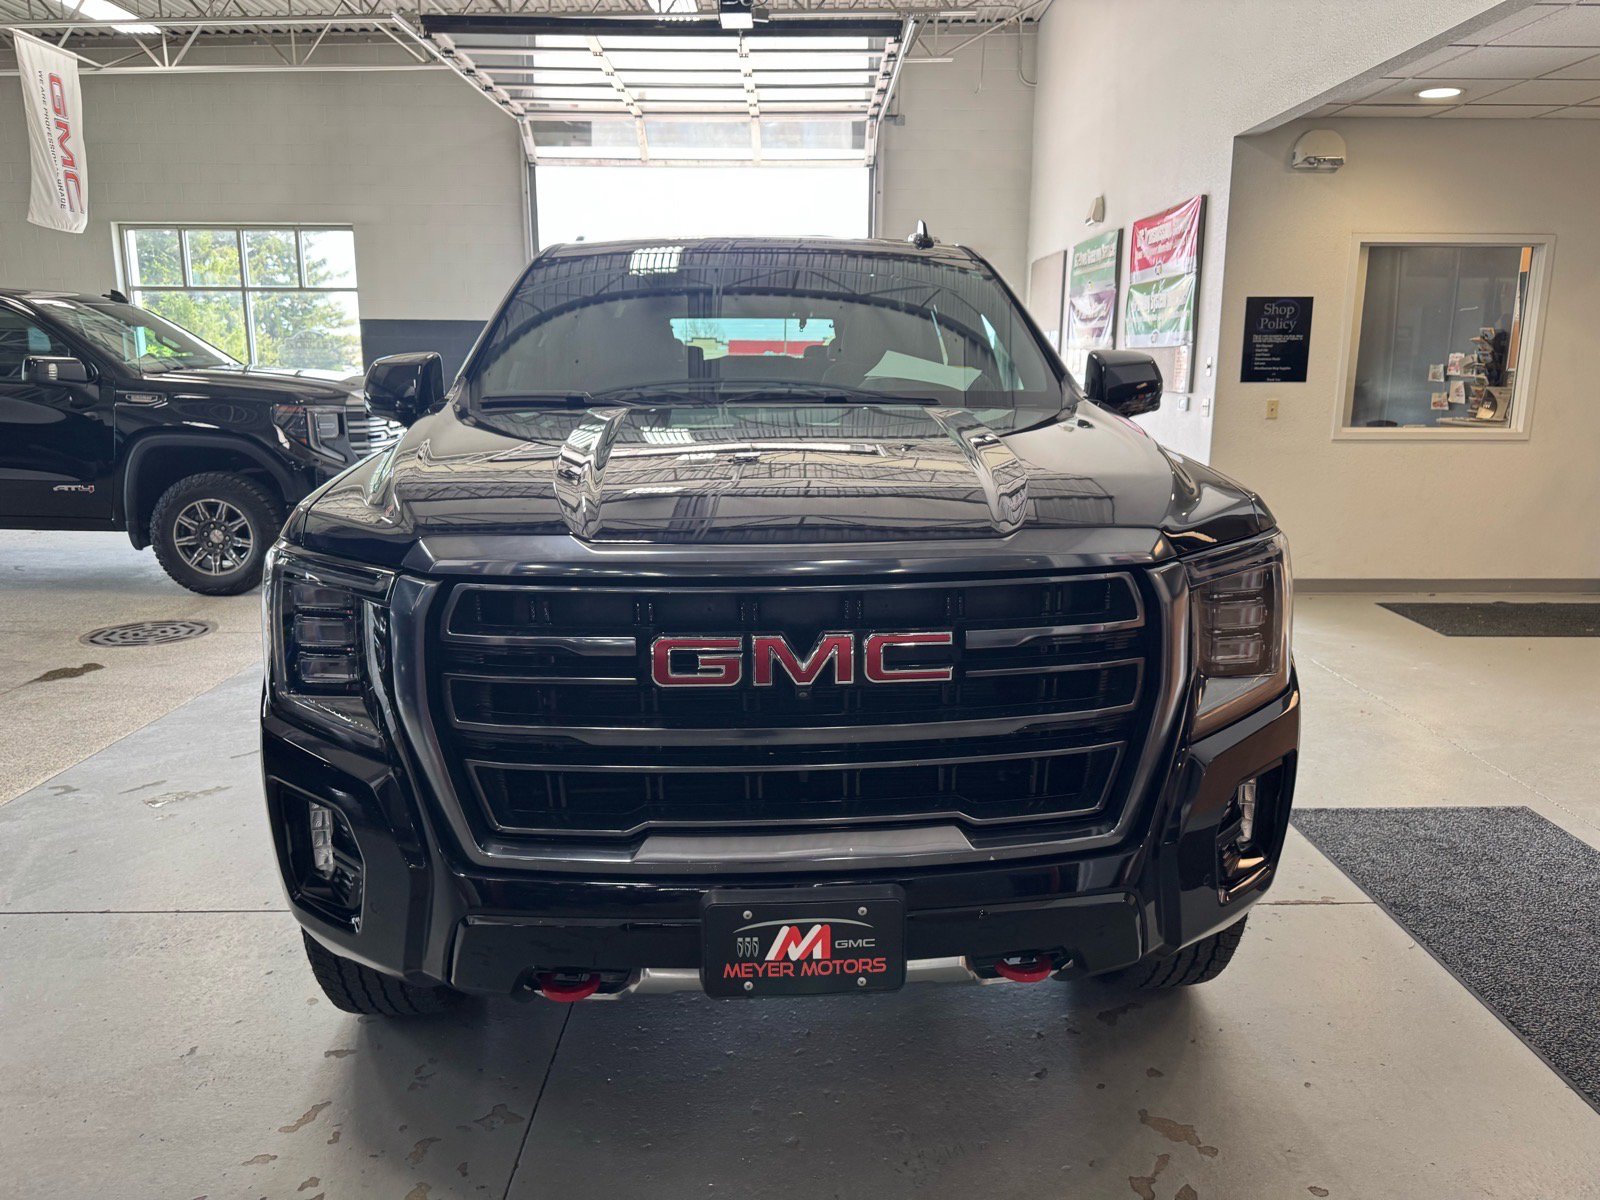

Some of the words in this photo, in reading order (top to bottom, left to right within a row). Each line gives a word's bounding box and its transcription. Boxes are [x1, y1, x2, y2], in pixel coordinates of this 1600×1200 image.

[38, 70, 44, 85] WE
[48, 73, 84, 214] GMC
[1263, 303, 1295, 318] Shop
[1260, 318, 1297, 333] Policy
[650, 630, 954, 688] GMC
[835, 938, 876, 949] GMC
[723, 961, 795, 978] MEYER
[800, 957, 887, 977] MOTORS
